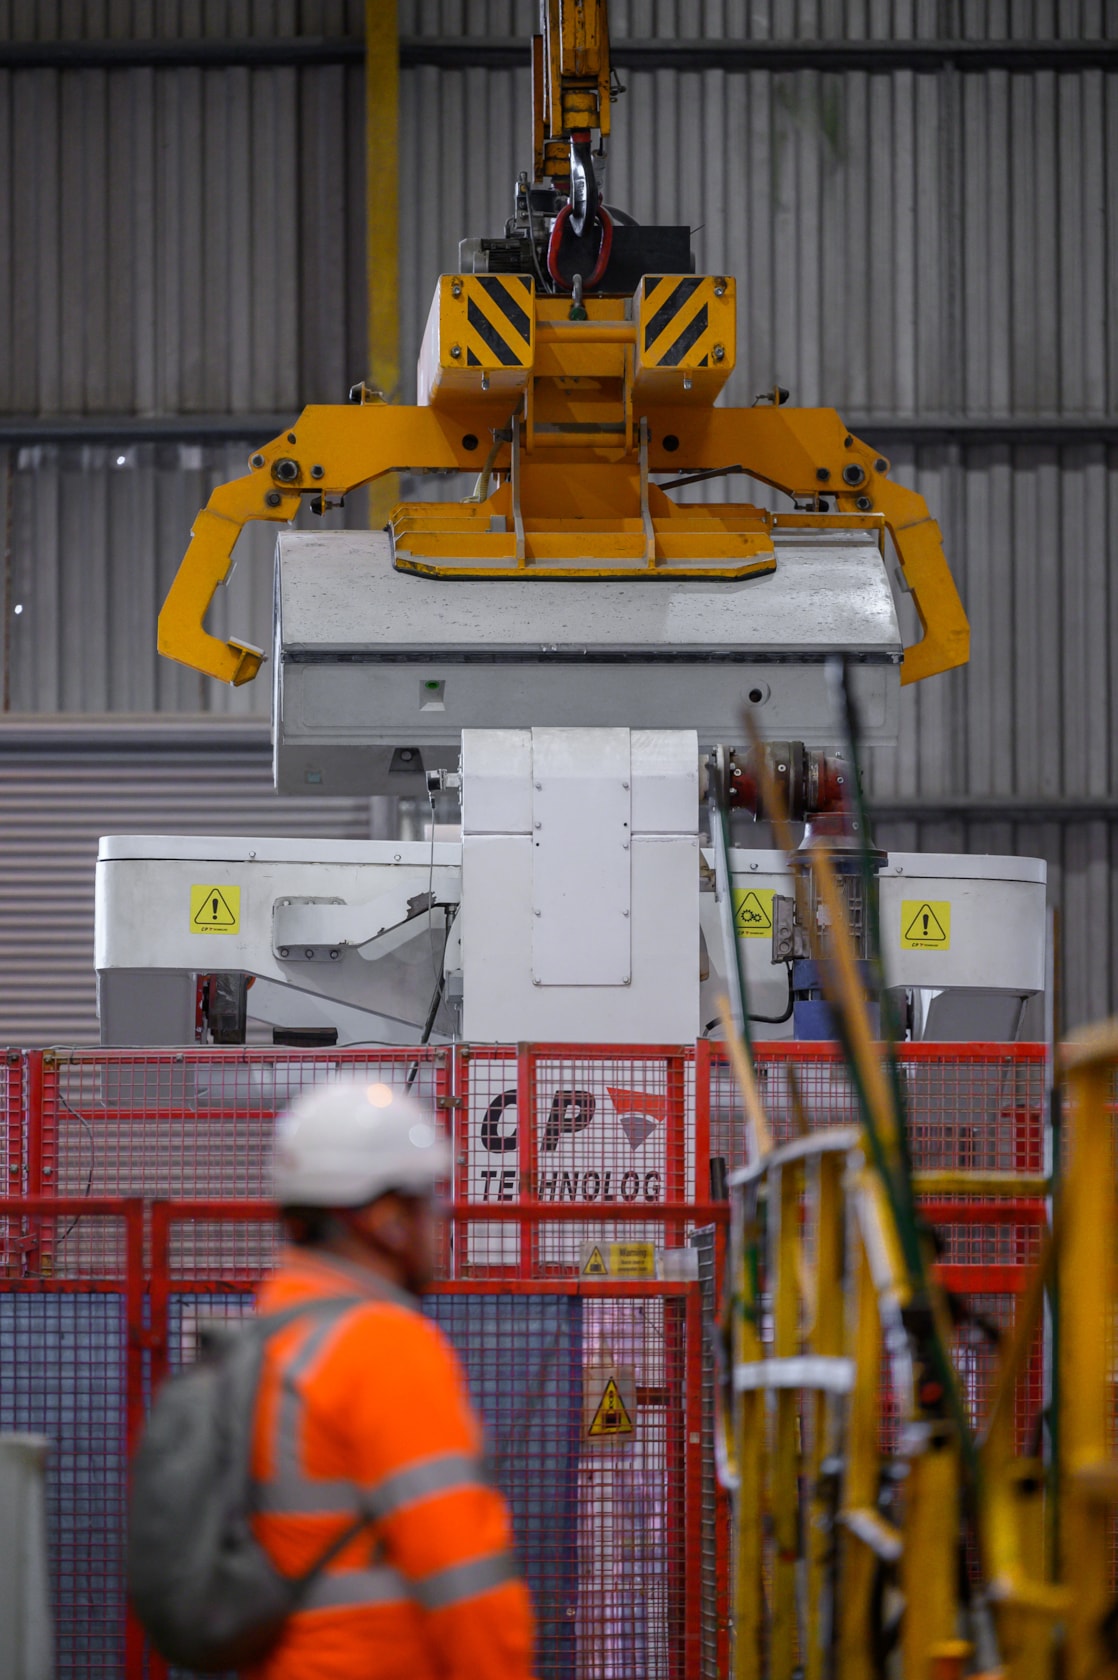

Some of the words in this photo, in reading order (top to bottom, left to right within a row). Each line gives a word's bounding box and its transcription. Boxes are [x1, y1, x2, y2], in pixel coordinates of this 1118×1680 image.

[480, 1089, 596, 1154] CP
[480, 1170, 662, 1202] TEHNOLOG
[619, 1248, 647, 1258] Warning
